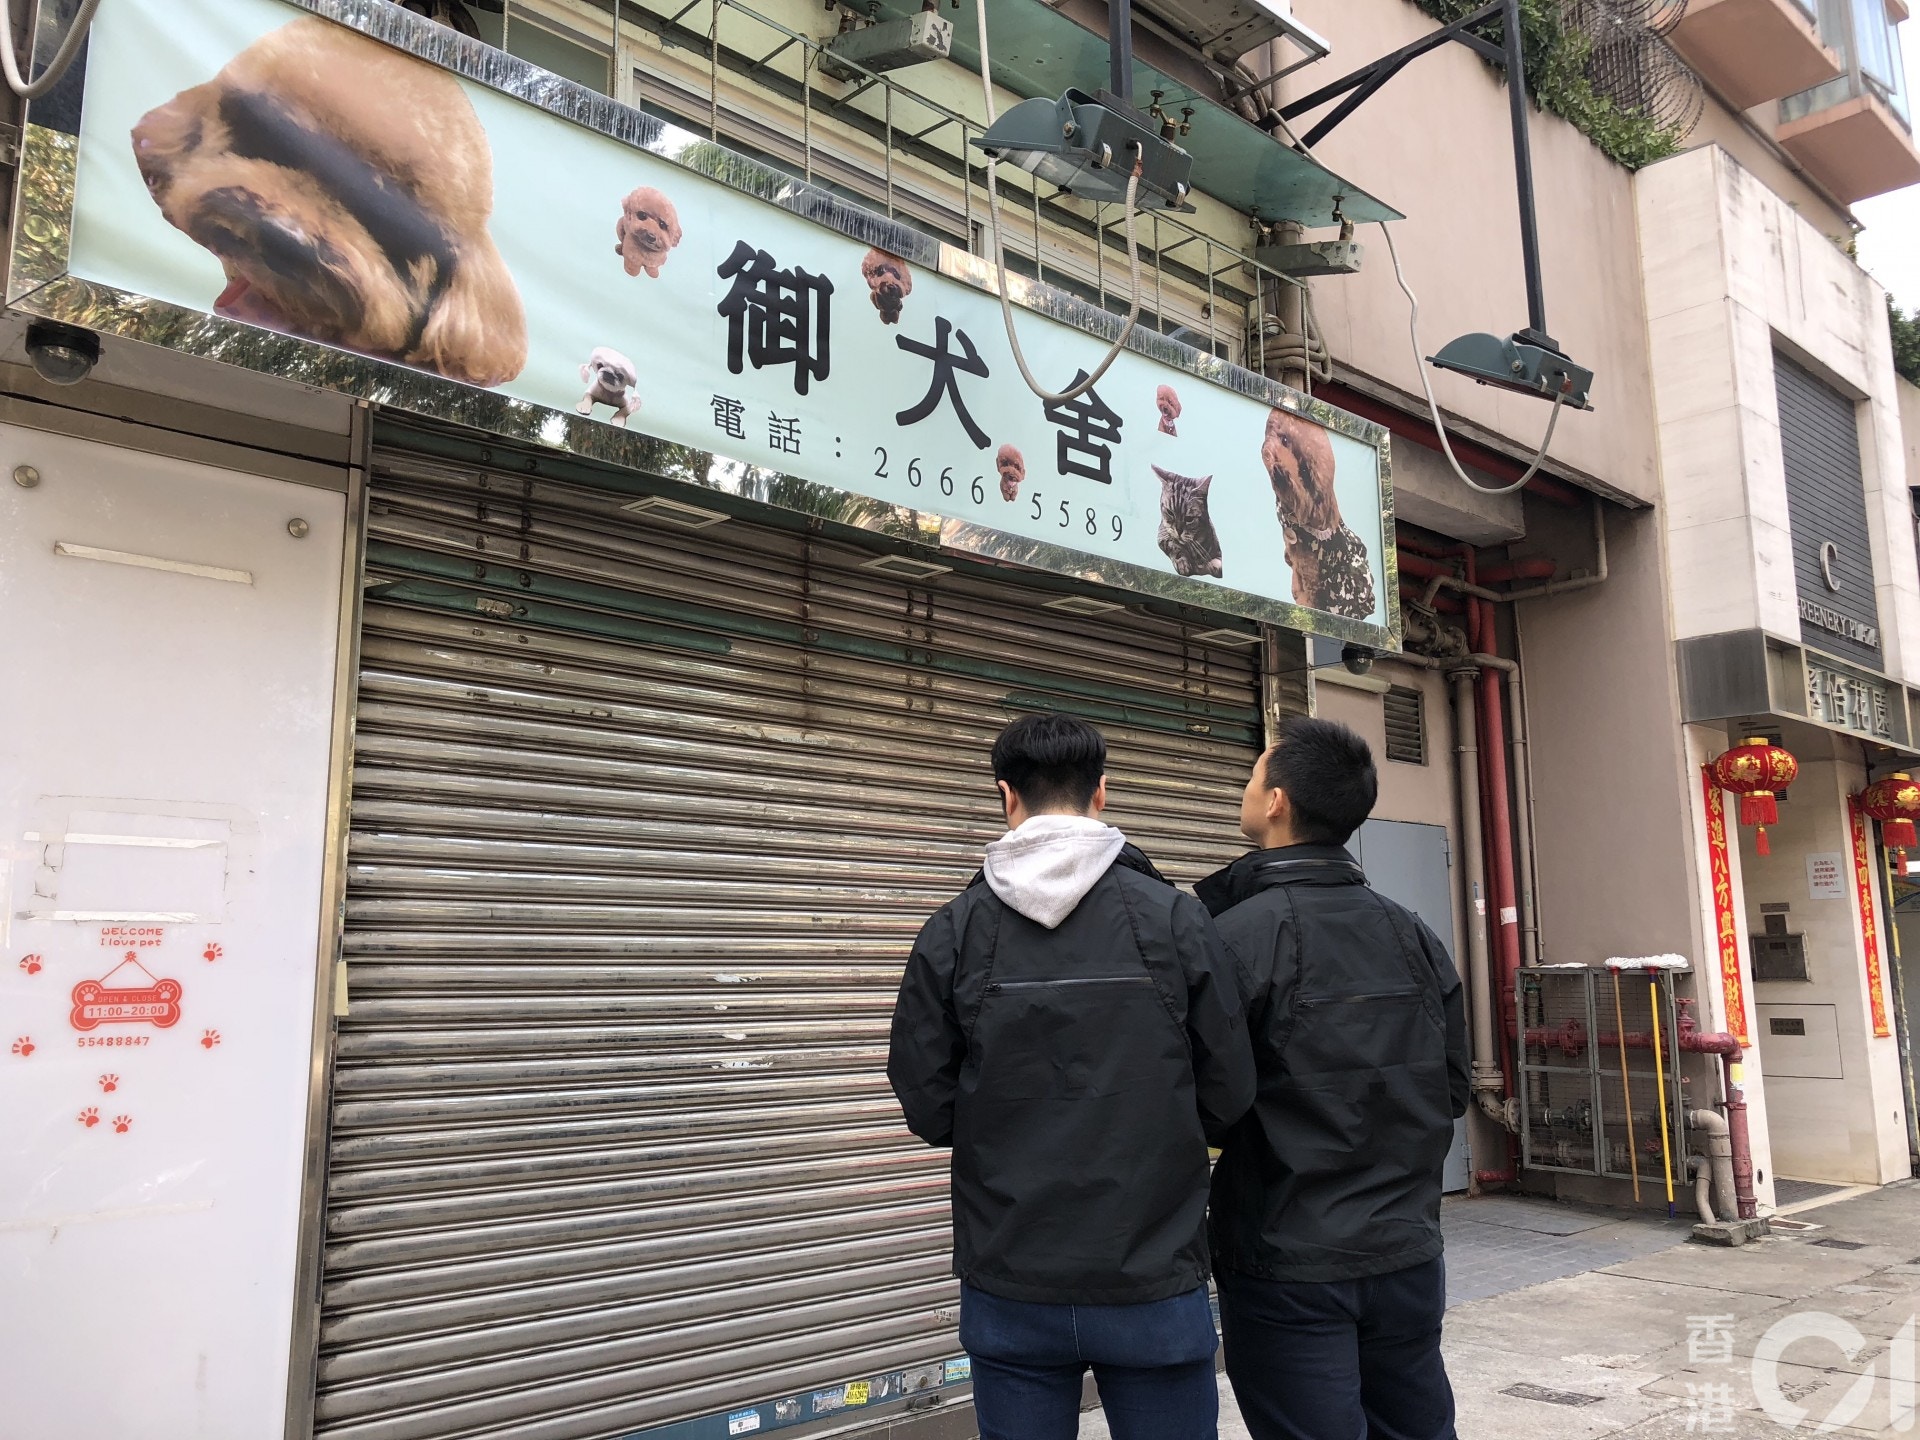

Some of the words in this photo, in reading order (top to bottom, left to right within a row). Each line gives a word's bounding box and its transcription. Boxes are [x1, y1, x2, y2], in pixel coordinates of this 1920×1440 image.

[718, 241, 1123, 484] 御犬舍
[875, 447, 985, 505] 2666
[1031, 493, 1123, 543] 5589
[1798, 598, 1846, 636] REENERY
[100, 938, 105, 946] I
[109, 938, 136, 946] love
[140, 938, 162, 947] pet
[101, 927, 163, 936] WELCOME
[132, 994, 157, 1002] CLOSE
